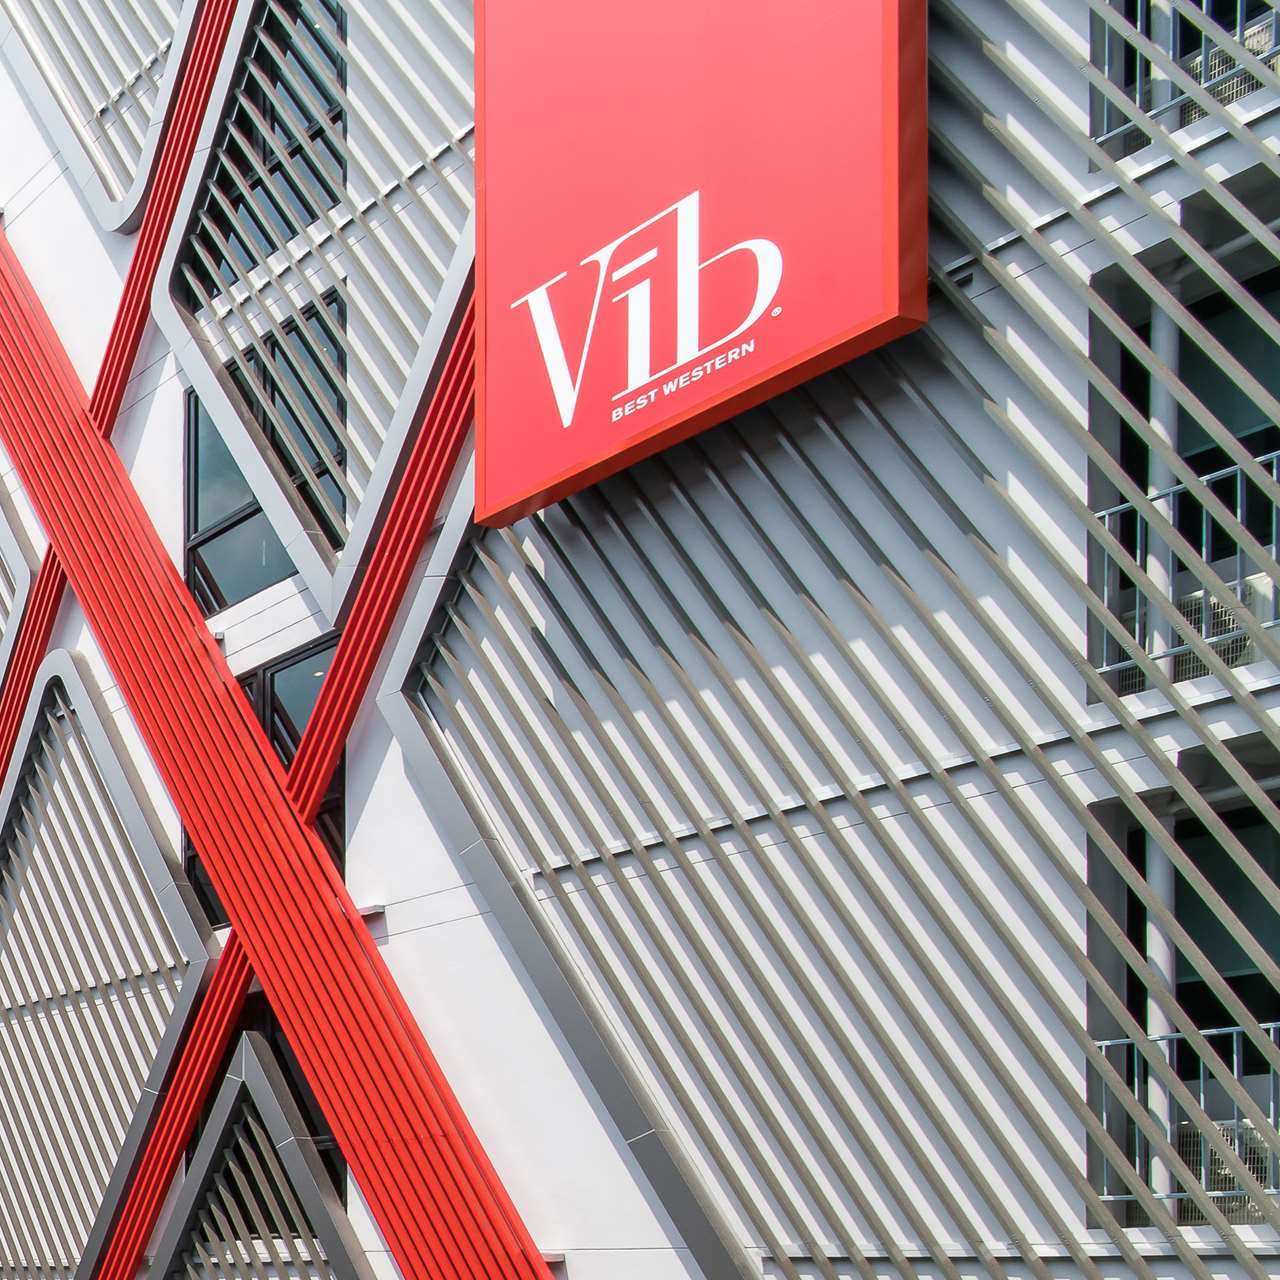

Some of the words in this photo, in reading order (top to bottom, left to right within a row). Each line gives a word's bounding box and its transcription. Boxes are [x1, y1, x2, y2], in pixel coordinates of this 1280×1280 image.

[510, 190, 783, 428] Vib
[611, 388, 657, 422] BEST
[662, 340, 755, 396] WESTERN
